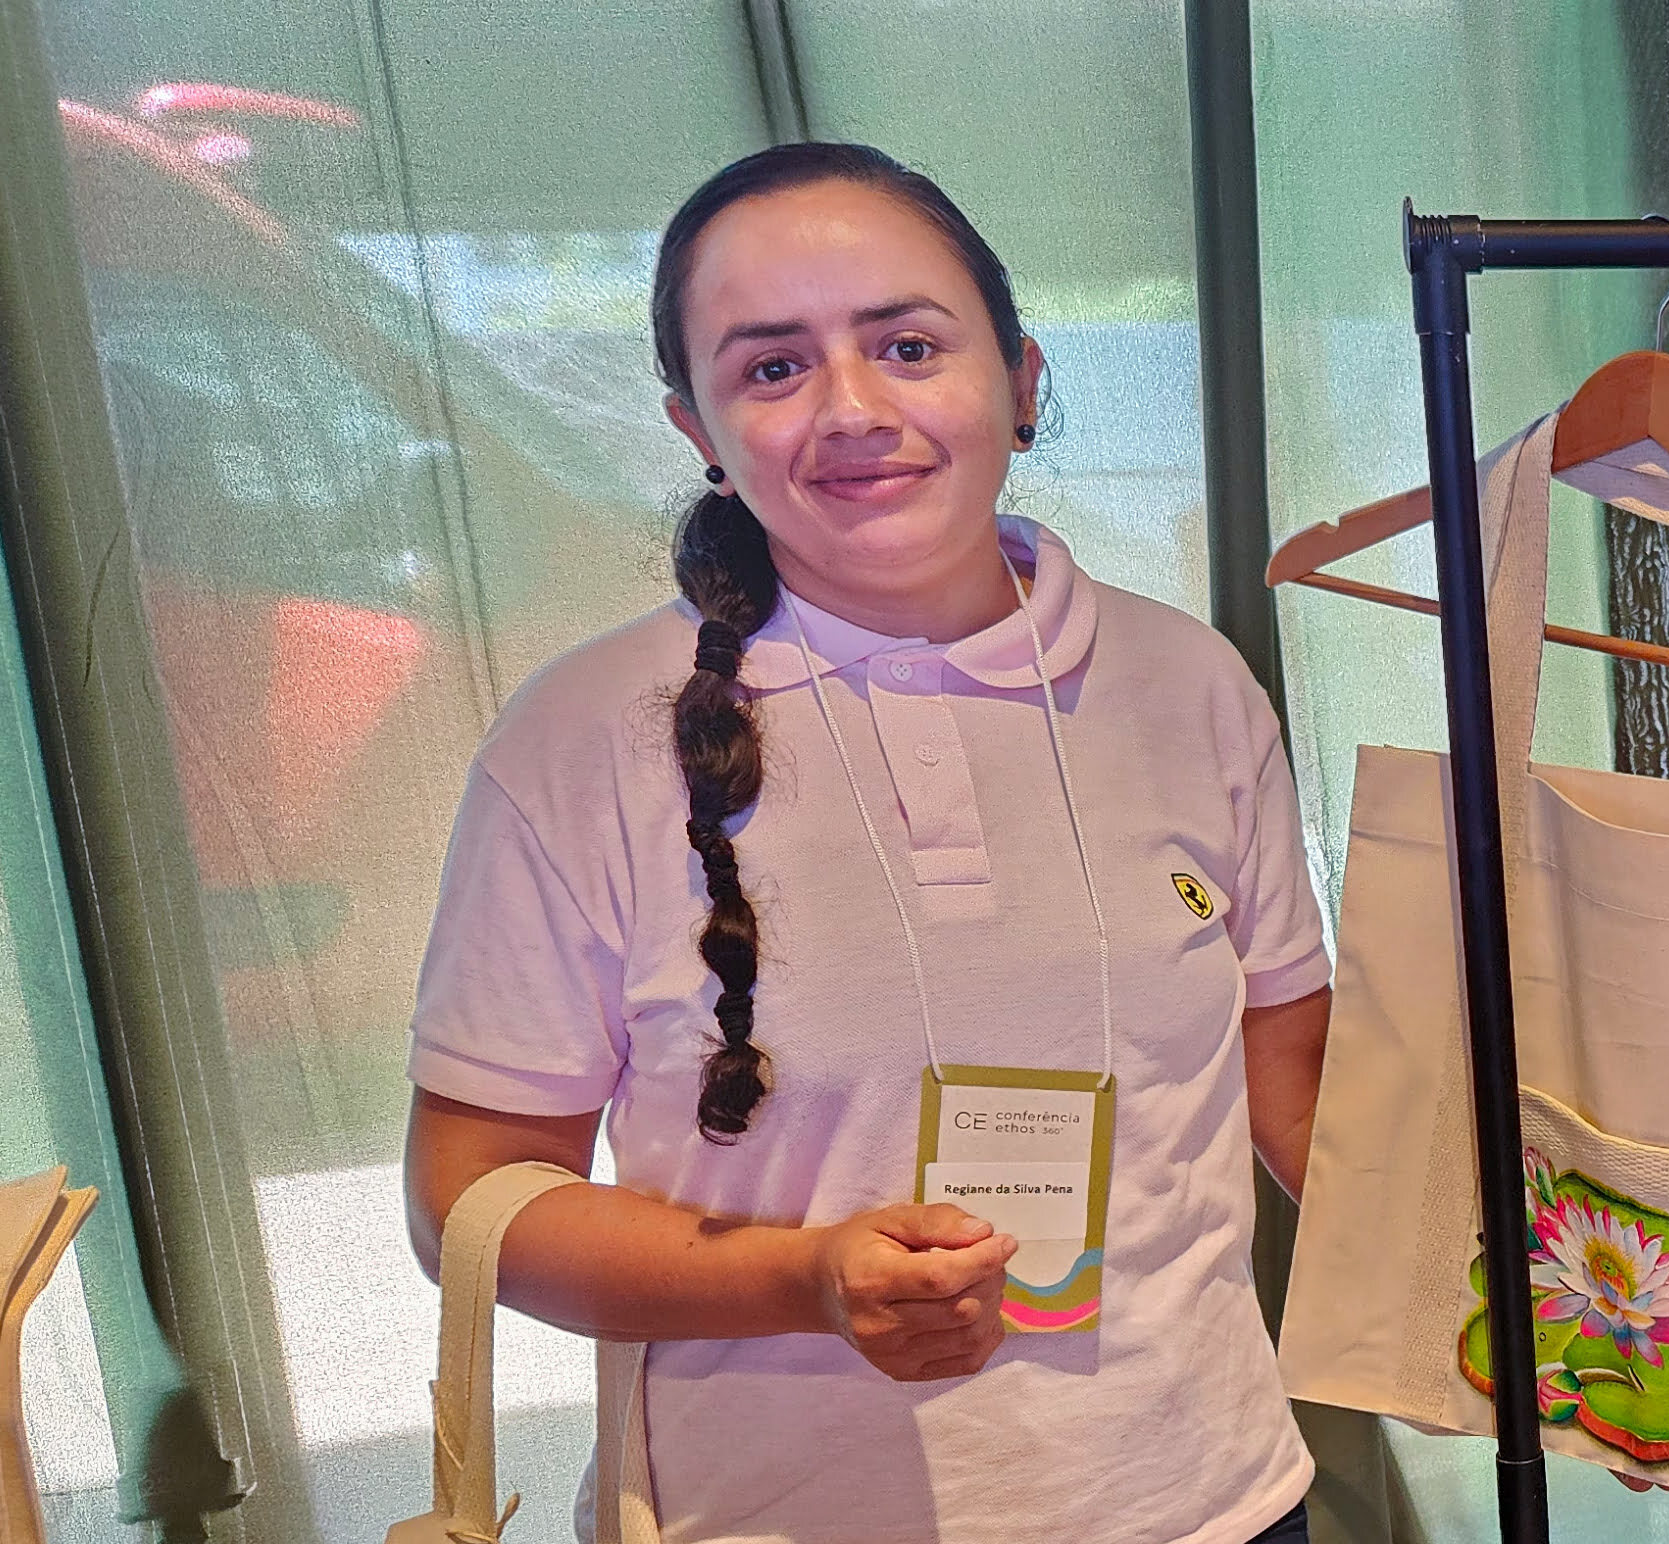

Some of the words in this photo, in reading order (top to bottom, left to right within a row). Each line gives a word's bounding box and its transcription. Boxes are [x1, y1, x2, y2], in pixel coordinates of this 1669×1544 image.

[995, 1110, 1080, 1124] conferência
[995, 1123, 1035, 1134] ethos
[944, 1184, 992, 1196] Regiane
[996, 1184, 1010, 1194] da
[1014, 1184, 1040, 1194] Silva
[1045, 1184, 1073, 1194] Pena
